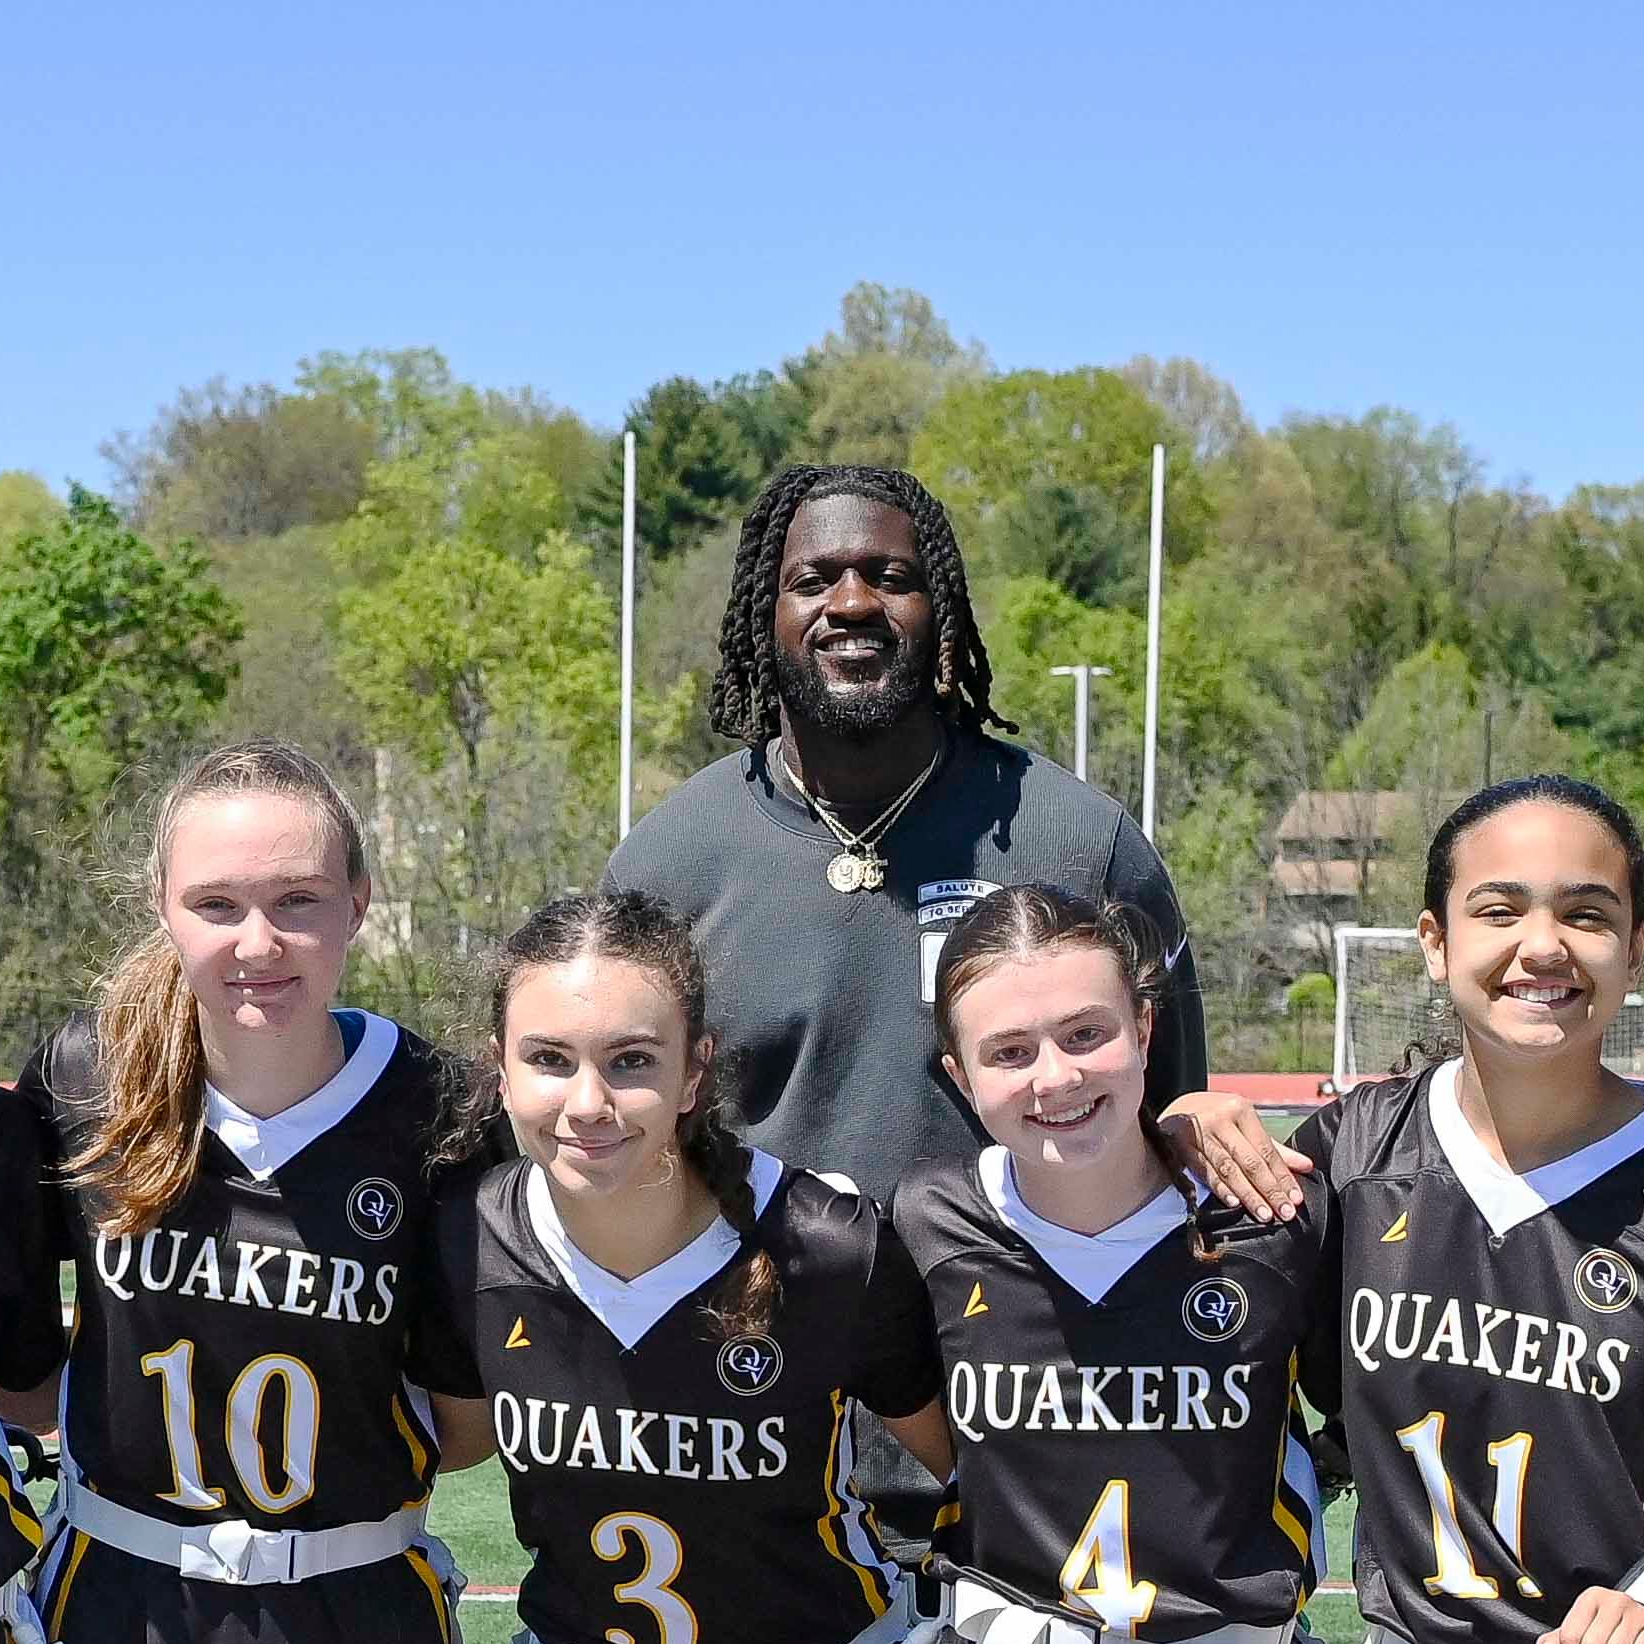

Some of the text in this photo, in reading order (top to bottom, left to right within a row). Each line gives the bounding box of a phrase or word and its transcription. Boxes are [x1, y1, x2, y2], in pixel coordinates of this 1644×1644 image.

[929, 907, 943, 918] TO
[936, 883, 984, 893] SALUTE
[94, 1228, 399, 1325] QUAKERS
[1350, 1288, 1630, 1403] QUAKERS
[140, 1338, 321, 1514] 10
[493, 1390, 788, 1481] QUAKERS
[950, 1361, 1252, 1442] QUAKERS
[1396, 1411, 1543, 1600] 11
[1059, 1480, 1157, 1638] 4
